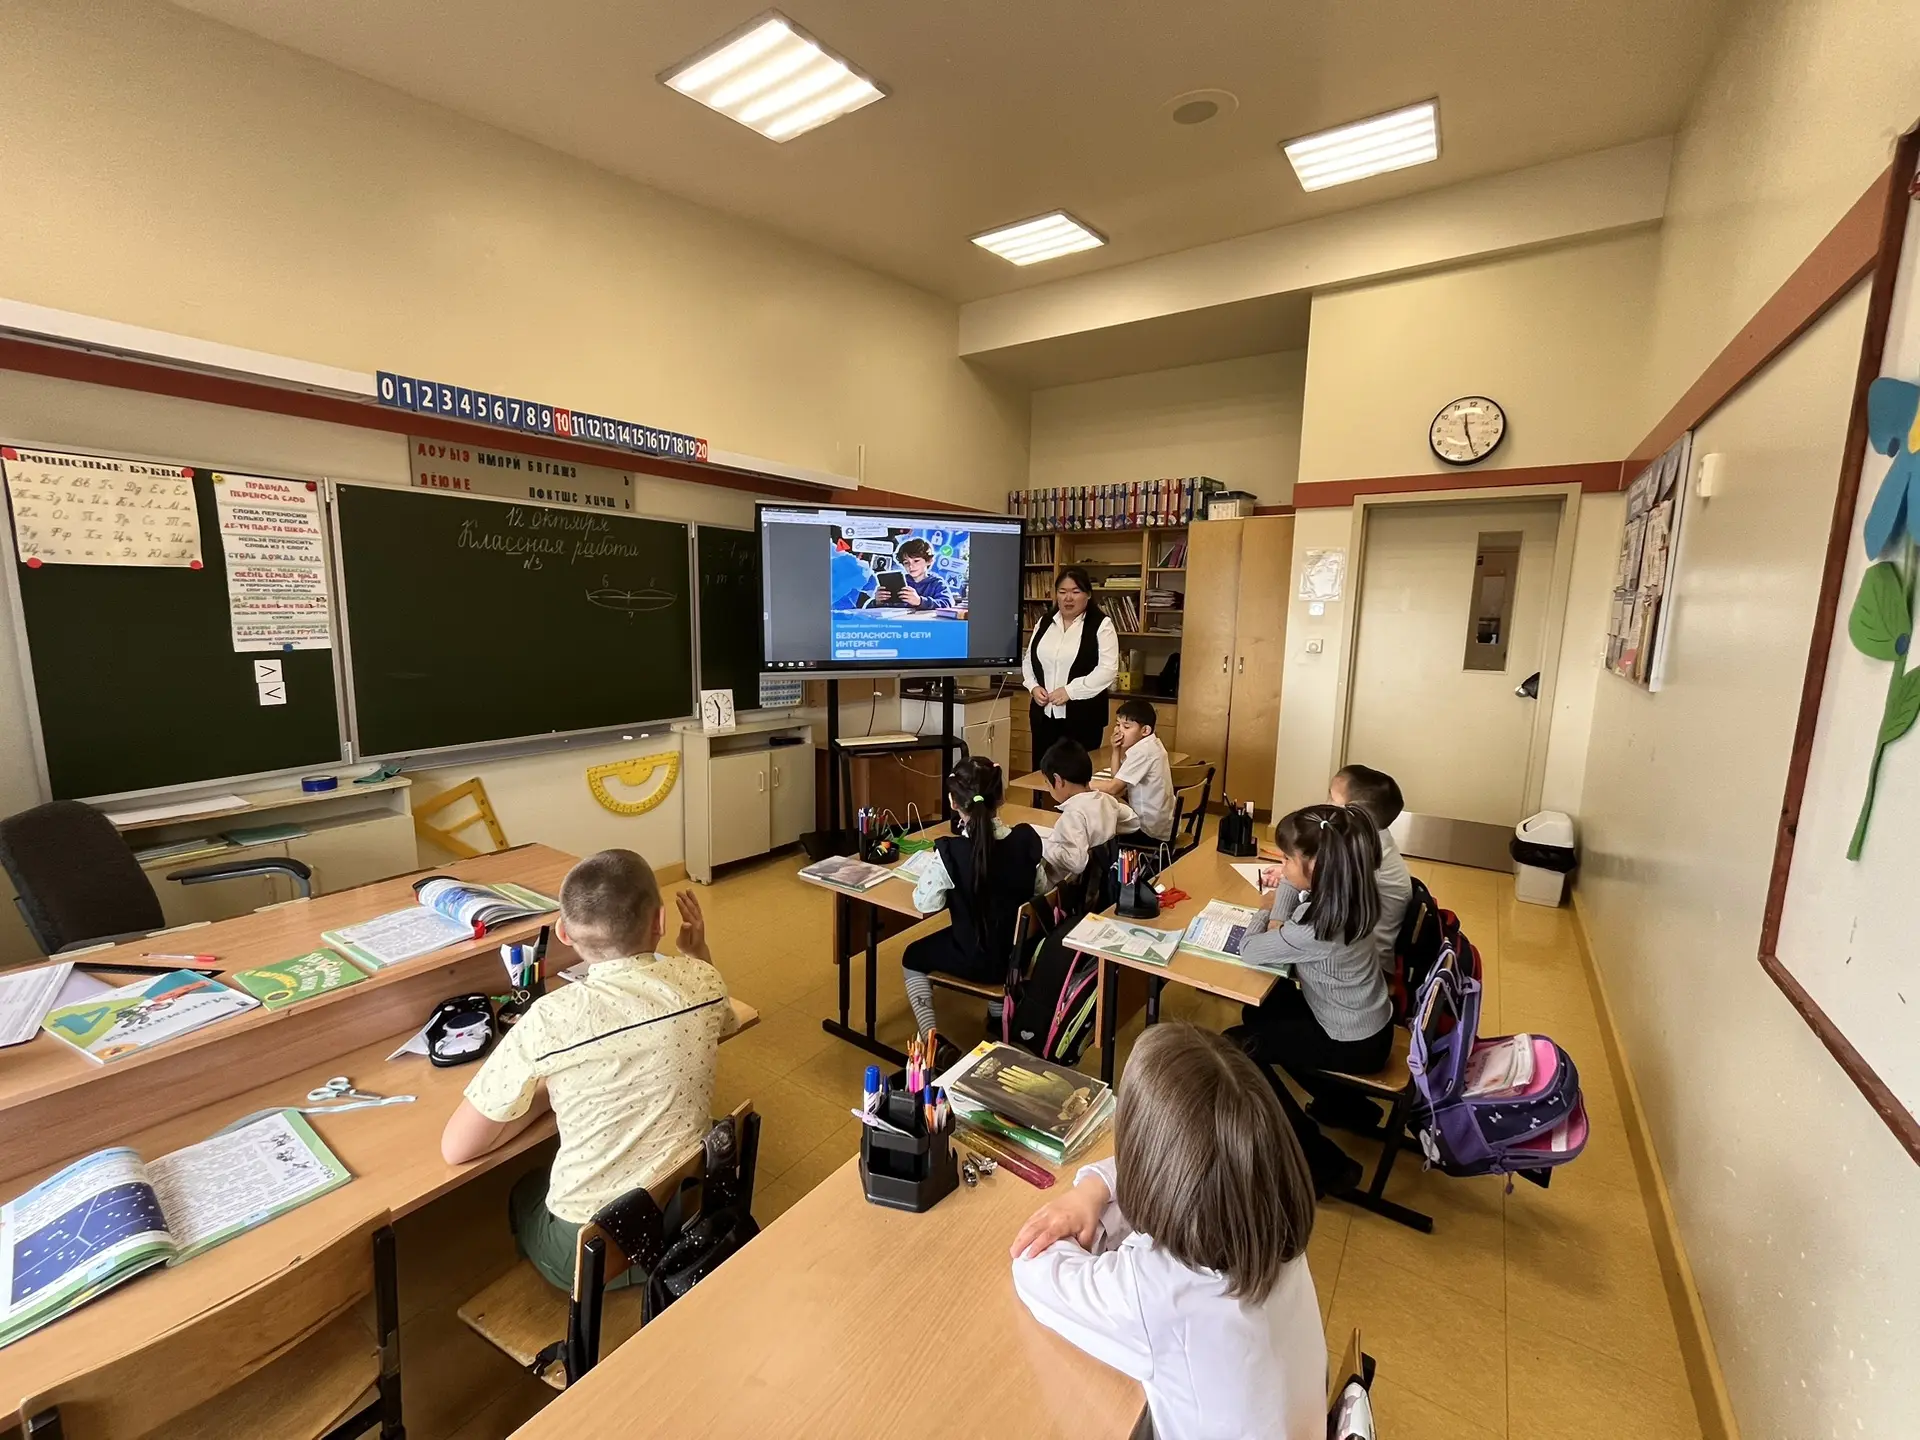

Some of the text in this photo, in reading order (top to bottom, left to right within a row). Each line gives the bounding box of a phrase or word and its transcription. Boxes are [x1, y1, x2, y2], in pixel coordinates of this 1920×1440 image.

[382, 378, 707, 458] 0 1 2 3 4 5 6 7 8 9 10 11 12 13 14 15 16 17 18 19 20
[17, 454, 124, 472] РОПИСНЫЕ
[230, 490, 306, 503] ПЕРЕНОСА СЛОВ
[246, 481, 290, 492] ПРАВИЛА
[506, 507, 610, 540] 12 октября
[458, 519, 639, 565] Классная работа
